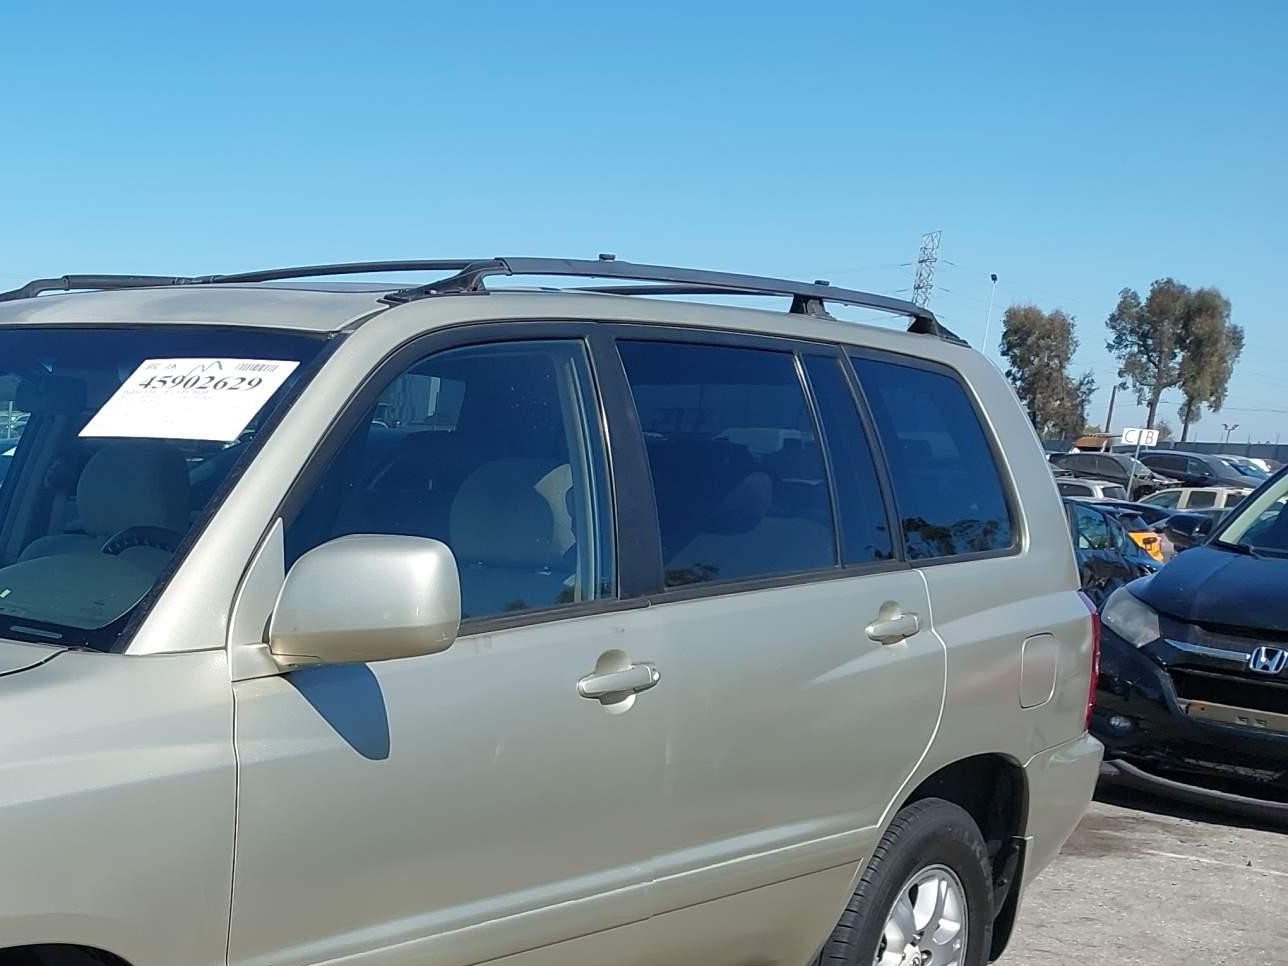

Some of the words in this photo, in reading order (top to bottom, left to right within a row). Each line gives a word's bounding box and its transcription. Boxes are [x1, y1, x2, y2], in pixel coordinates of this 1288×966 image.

[138, 374, 263, 391] 45902629
[1125, 429, 1136, 443] C
[1145, 430, 1154, 444] B
